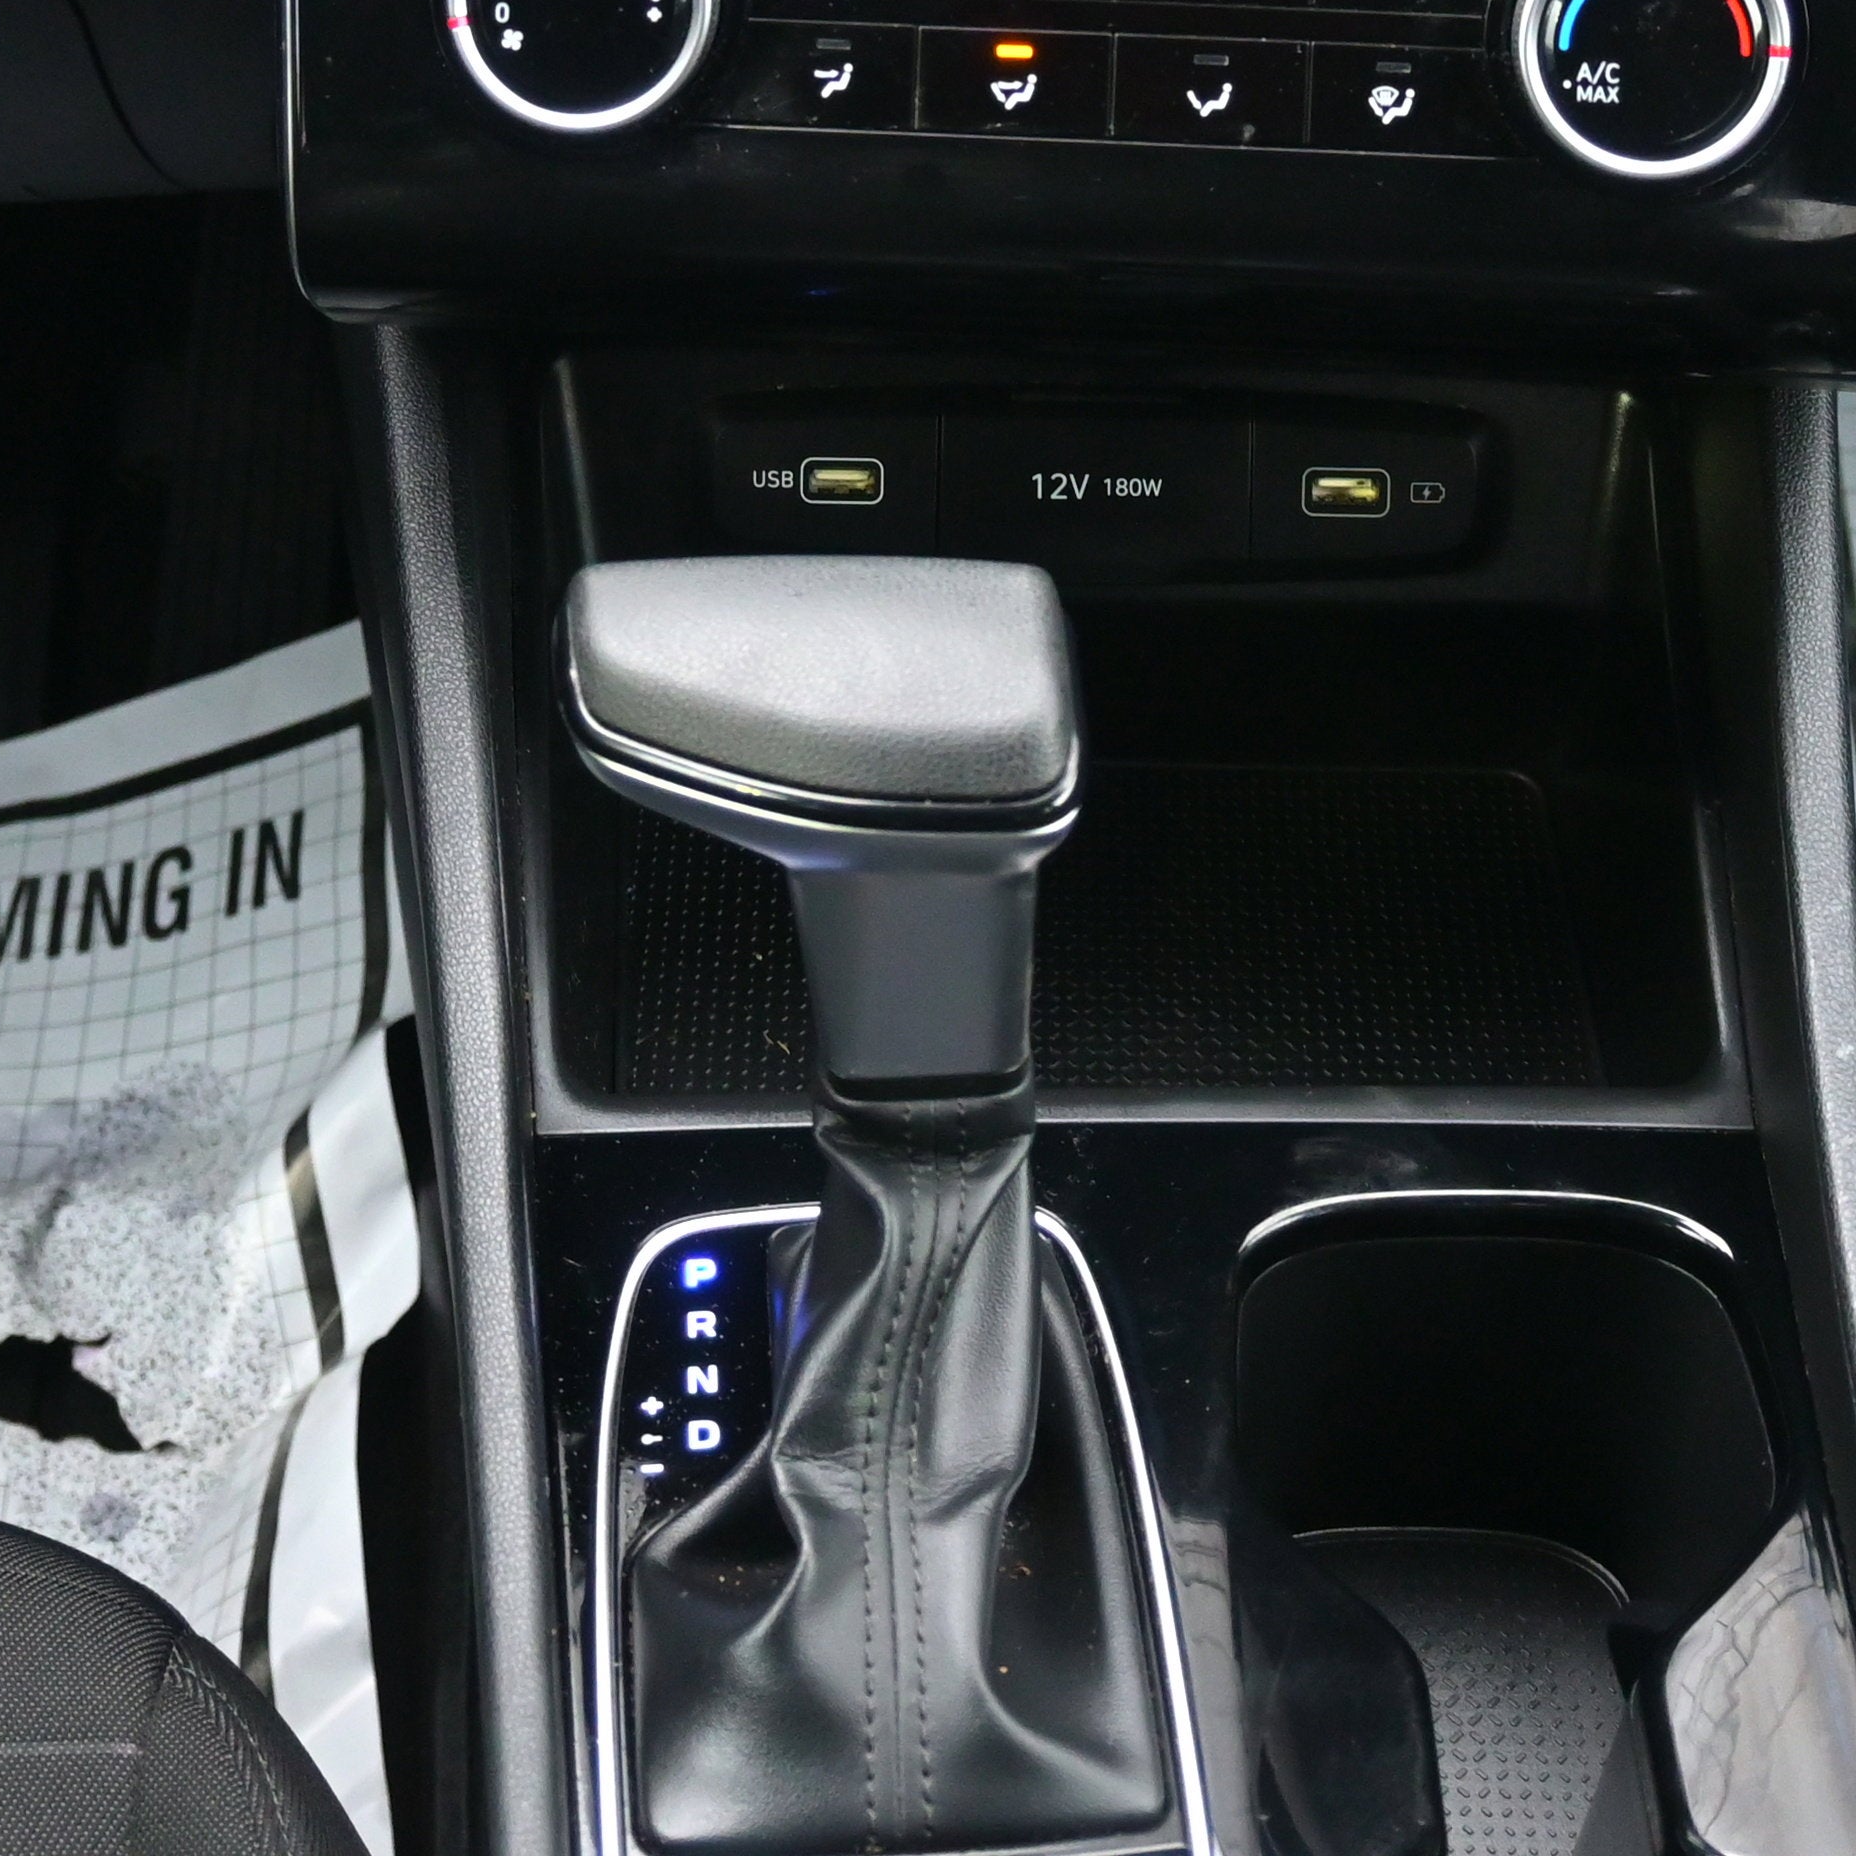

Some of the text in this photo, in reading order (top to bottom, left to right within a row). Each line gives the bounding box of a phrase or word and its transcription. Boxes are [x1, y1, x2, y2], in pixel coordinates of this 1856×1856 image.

[1576, 61, 1621, 85] A/C
[1576, 84, 1620, 104] MAX
[752, 470, 794, 490] USB
[1031, 473, 1163, 501] 12V 180W
[225, 809, 304, 916] IN
[684, 1258, 717, 1288] P
[687, 1311, 717, 1338] R
[687, 1365, 718, 1394] N
[688, 1420, 721, 1450] D
